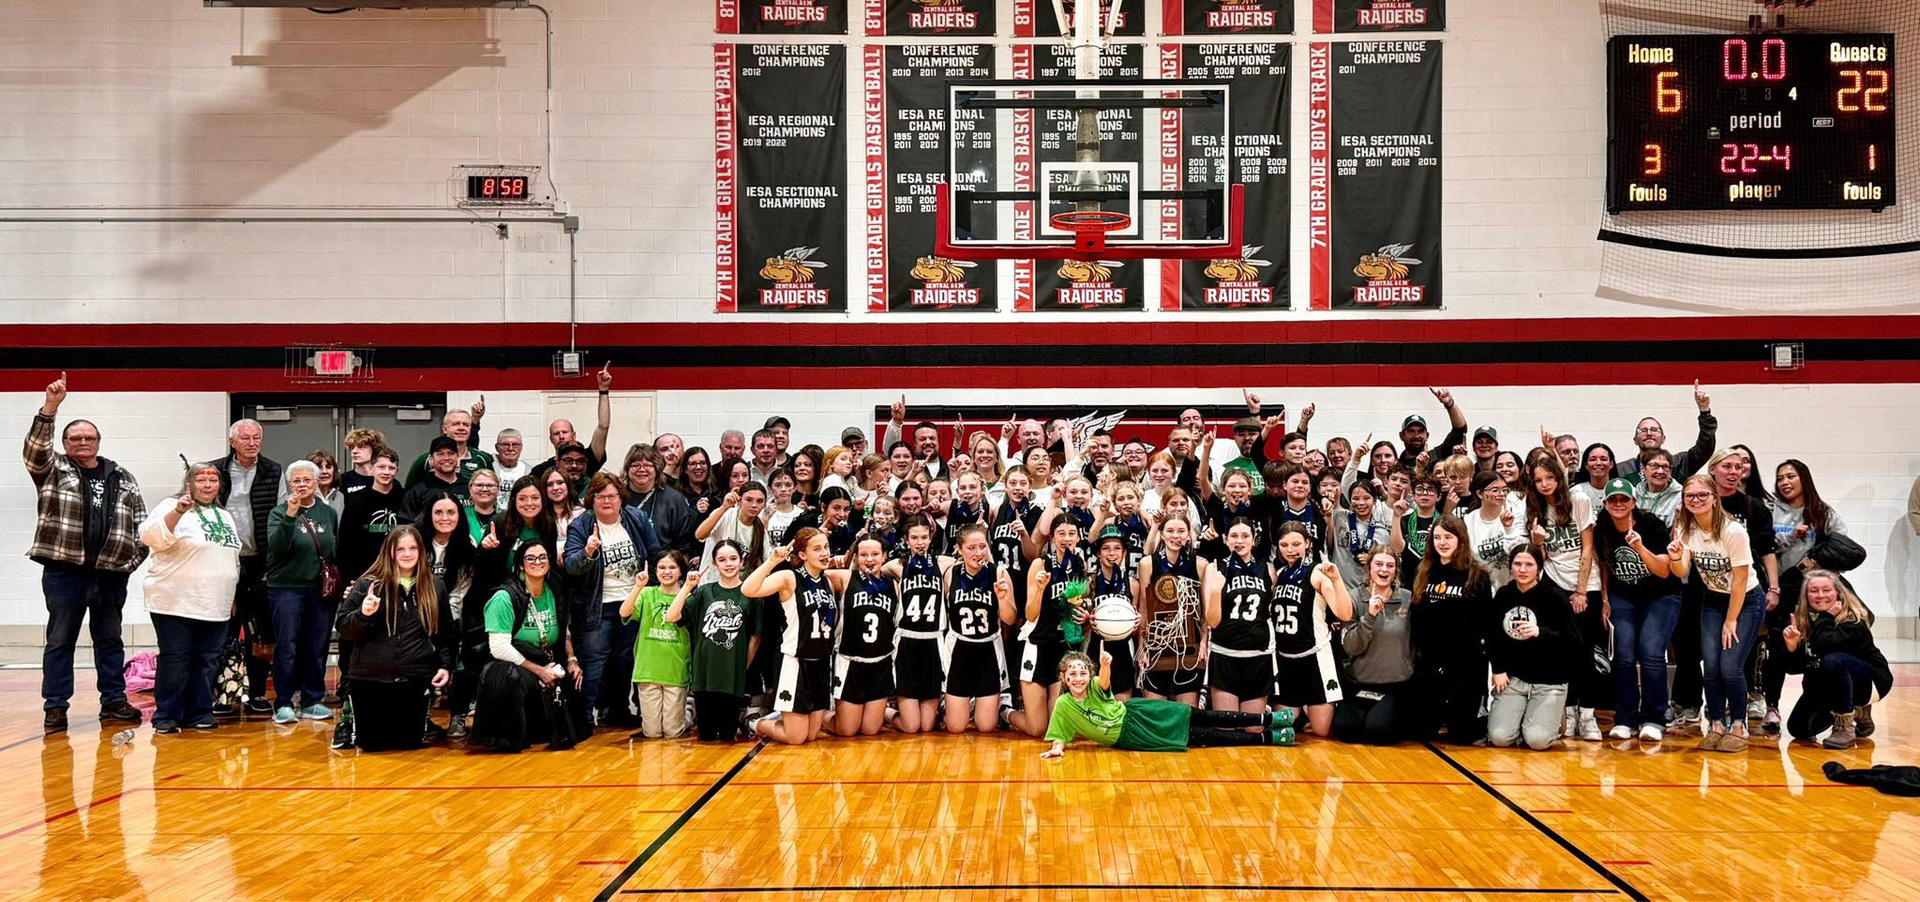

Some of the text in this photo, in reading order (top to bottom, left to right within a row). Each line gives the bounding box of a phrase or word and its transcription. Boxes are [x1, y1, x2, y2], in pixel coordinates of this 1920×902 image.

[764, 6, 825, 20] RAIDERS
[1210, 12, 1273, 27] RAIDERS
[1360, 9, 1425, 25] RAIDERS
[911, 13, 975, 28] RAIDERS
[753, 45, 830, 55] CONFERENCE
[902, 45, 979, 56] CONFERENCE
[1051, 45, 1128, 56] CONENCE
[1199, 44, 1276, 55] CONFERENCE
[1348, 41, 1426, 53] CONFERENCE
[1629, 43, 1674, 64] Home
[1830, 42, 1887, 62] Guests
[758, 57, 825, 67] CHAMPIONS
[908, 57, 974, 67] CHAMPIONS
[1057, 56, 1123, 67] CHAONS
[1205, 55, 1271, 66] CHAMPIONS
[1354, 53, 1421, 64] CHAMPIONS
[1724, 39, 1786, 79] 0.0
[742, 68, 761, 76] 2012
[892, 68, 989, 77] 2010 2011 2013 2014
[1041, 68, 1139, 76] 1997 2015
[1187, 66, 1286, 76] 2005 2008 2010 2011
[1339, 65, 1356, 74] 2011
[1657, 71, 1681, 112] 6
[1788, 86, 1797, 100] 4
[1838, 70, 1888, 111] 22
[748, 115, 836, 126] IESA REGIONAL
[899, 109, 924, 120] IESA
[1047, 110, 1072, 120] IESA
[1730, 110, 1782, 132] period
[759, 127, 826, 137] CHAMPIONS
[909, 121, 975, 131] CHAMONS
[1057, 121, 1123, 131] CHAONS
[894, 132, 991, 140] 1995 2004 2010
[1121, 132, 1137, 140] 2011
[1162, 110, 1178, 158] GIRLS
[1191, 135, 1282, 146] IESA SCTIONAL
[1341, 134, 1434, 146] IESA SECTIONAL
[894, 141, 911, 149] 2011
[920, 141, 938, 149] 2013
[1042, 141, 1060, 149] 2015
[1204, 146, 1271, 157] CHAPIONS
[1311, 47, 1327, 248] 7TH GRADE BOYS TRACK
[1354, 146, 1421, 157] CHAMPIONS
[1240, 158, 1261, 166] 2008
[1267, 158, 1287, 166] 2009
[1337, 157, 1437, 167] 2008 2011 2012 2013
[1645, 144, 1661, 174] 3
[1868, 144, 1876, 171] 1
[715, 48, 732, 302] 7TH GRADE GIRLS VOLLEYBALL
[865, 49, 883, 305] 7TH GRADE GIRLS BASKETBALL
[897, 173, 988, 183] IESA SECIONAL
[1014, 162, 1029, 192] OYS
[1049, 173, 1069, 183] ESA
[1338, 167, 1356, 175] 2019
[1188, 175, 1260, 183] 2014 2019
[746, 186, 838, 197] IESA SECTIONAL
[1629, 183, 1668, 202] fouls
[1729, 180, 1782, 202] player
[1843, 182, 1882, 201] fouls
[760, 198, 826, 208] CHAMPIONS
[895, 196, 912, 204] 1995
[1162, 222, 1178, 240] TH
[1015, 269, 1031, 300] 7TH
[763, 290, 826, 304] RAIDERS
[914, 289, 977, 304] RAIDERS
[1060, 289, 1123, 303] RAIDERS
[1207, 288, 1270, 303] RAIDERS
[1356, 287, 1421, 301] RAIDERS
[994, 522, 1021, 541] IRIS
[998, 542, 1021, 571] 31
[1613, 561, 1650, 577] RISH
[903, 573, 941, 594] IRISH
[954, 587, 993, 606] IRISH
[1275, 584, 1303, 604] RISH
[853, 591, 892, 613] IRISH
[906, 594, 937, 622] 44
[1230, 594, 1260, 621] 13
[702, 613, 743, 634] Irish
[959, 607, 989, 635] 23
[1275, 604, 1298, 634] 25
[862, 612, 879, 643] 3
